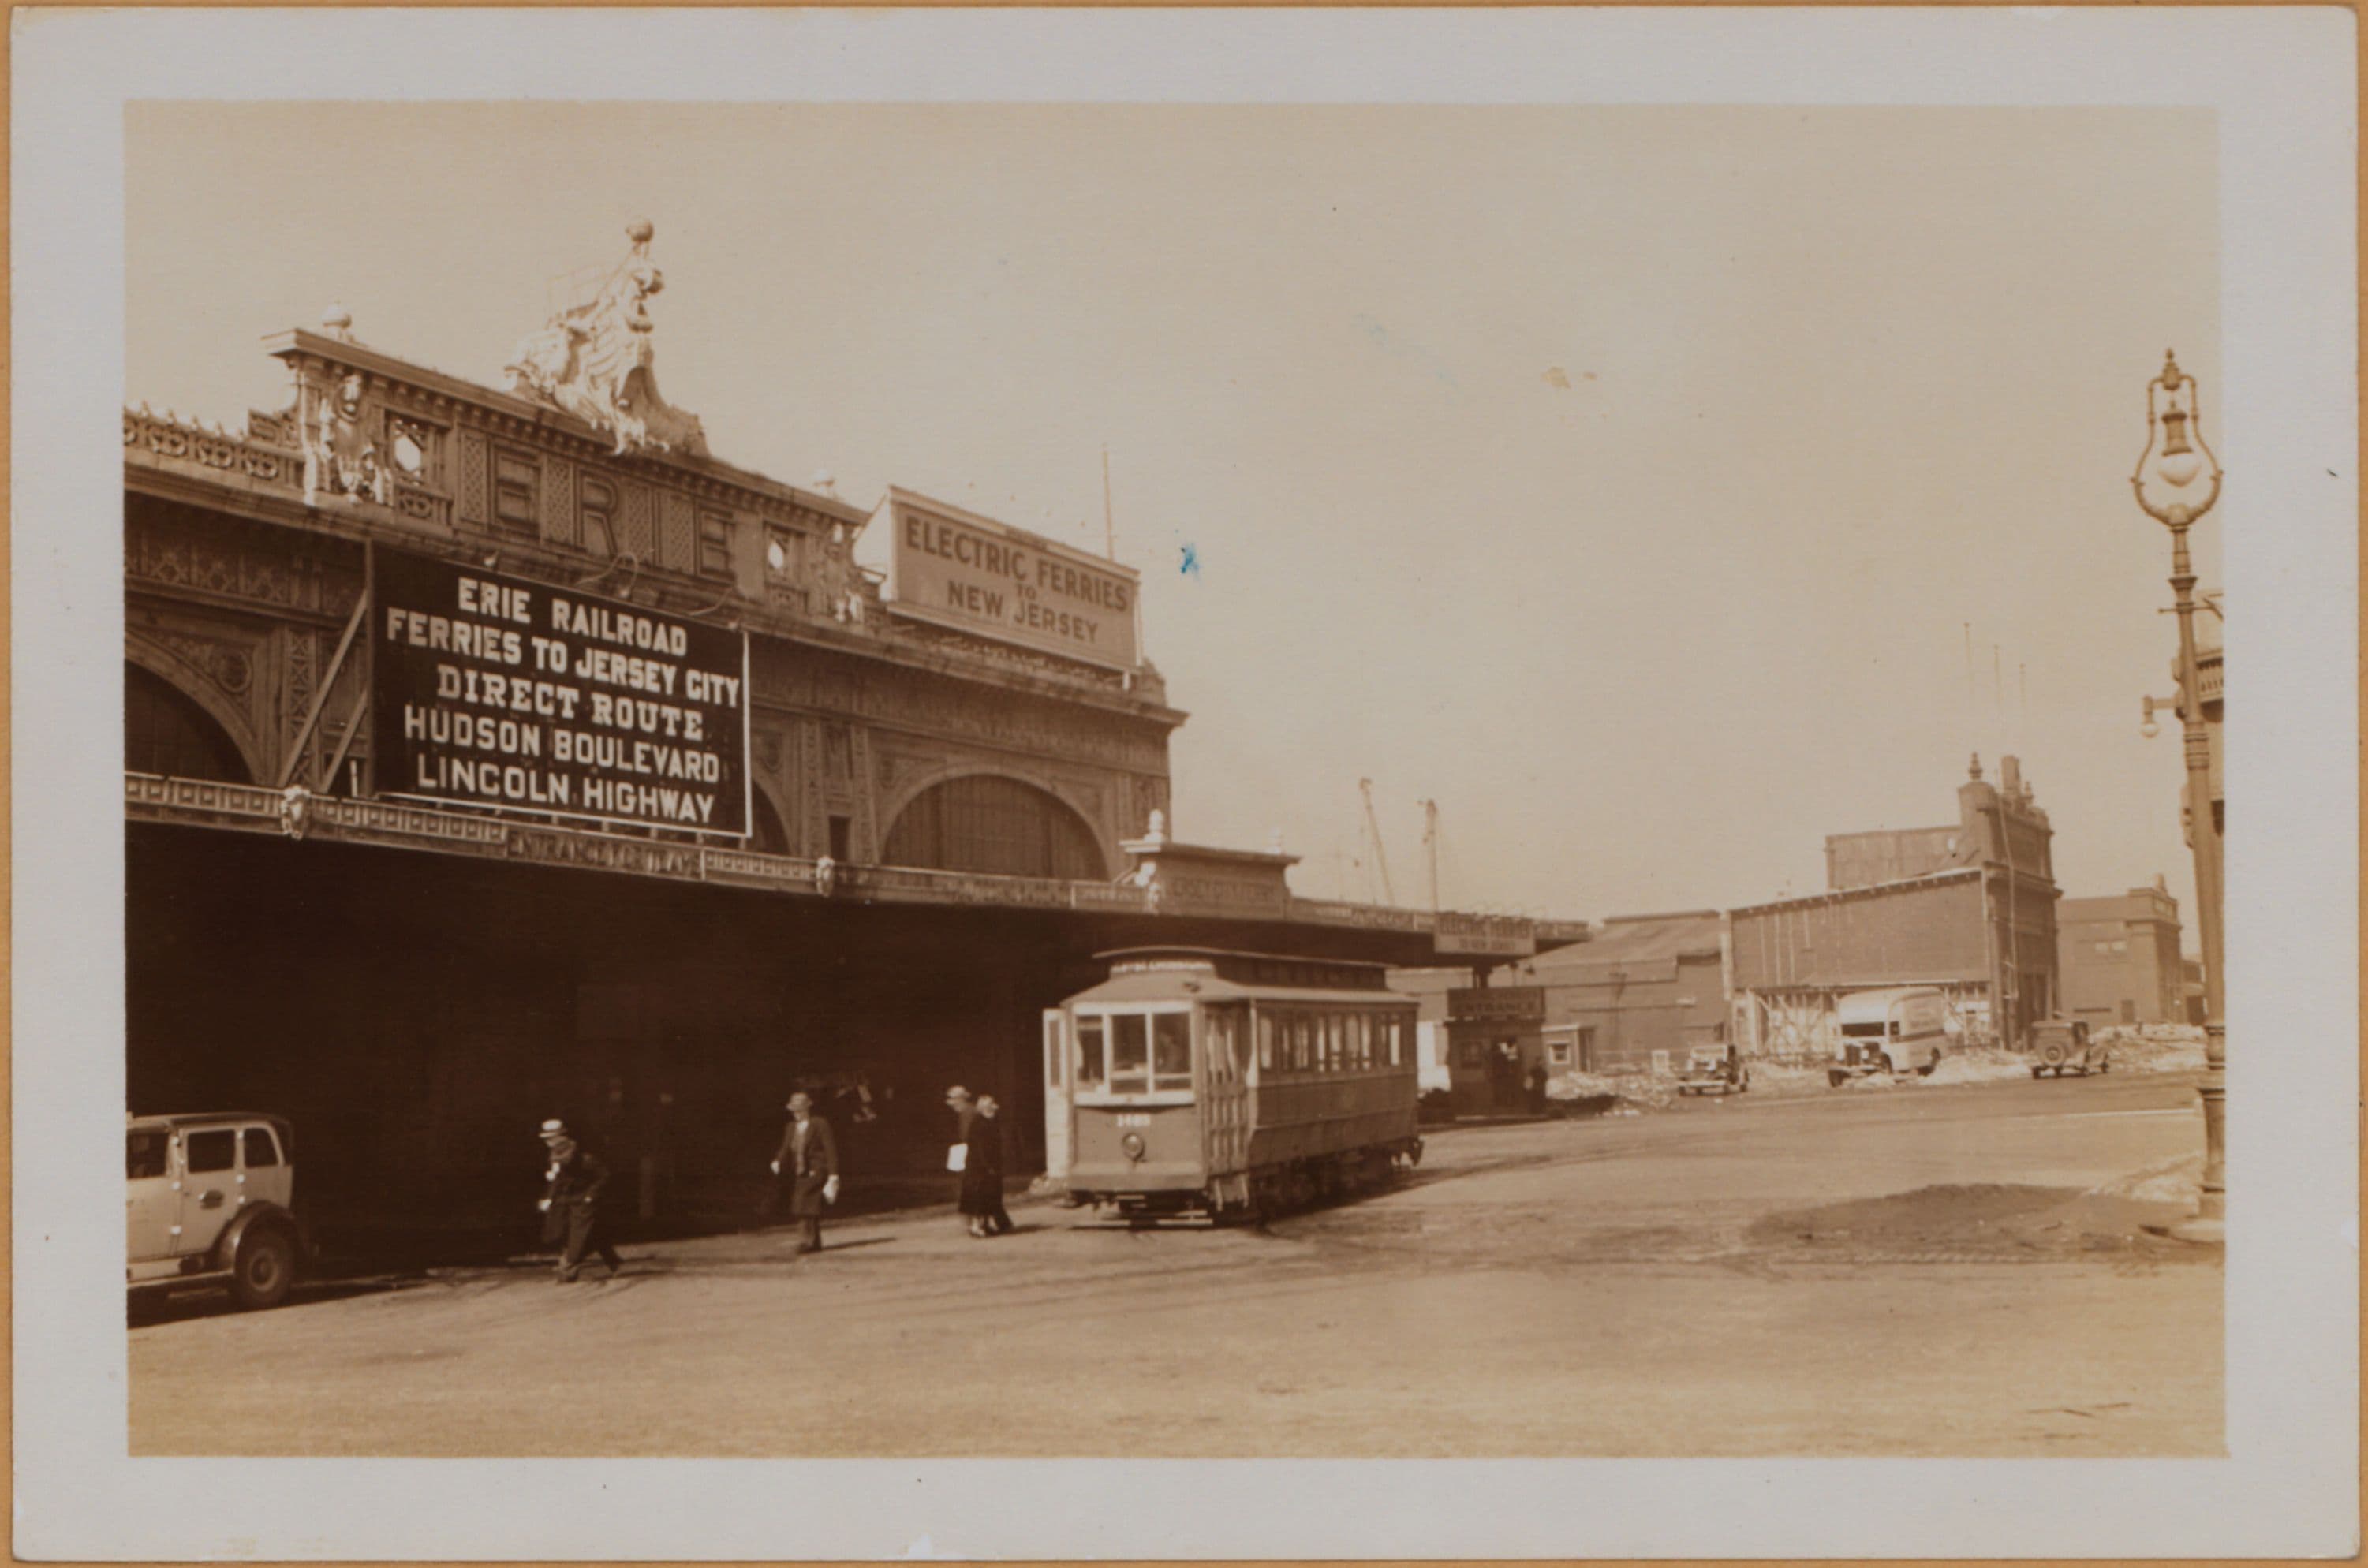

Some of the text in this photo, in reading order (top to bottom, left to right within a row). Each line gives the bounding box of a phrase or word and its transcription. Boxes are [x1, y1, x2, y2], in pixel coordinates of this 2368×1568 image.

[491, 447, 737, 582] ERIE
[905, 515, 1129, 613] ELECTRIC FERRIES
[1016, 582, 1037, 601] TO
[458, 577, 688, 657] ERIE RAILROAD
[947, 580, 1100, 644] NEW JERSEY
[387, 607, 739, 708] FERRIES TO JERSEY CITY
[436, 663, 703, 741] DIRECT ROUTE
[404, 704, 719, 784] HUDSON BOULEVARD
[417, 753, 715, 824] LINCOLN HIGHWAY
